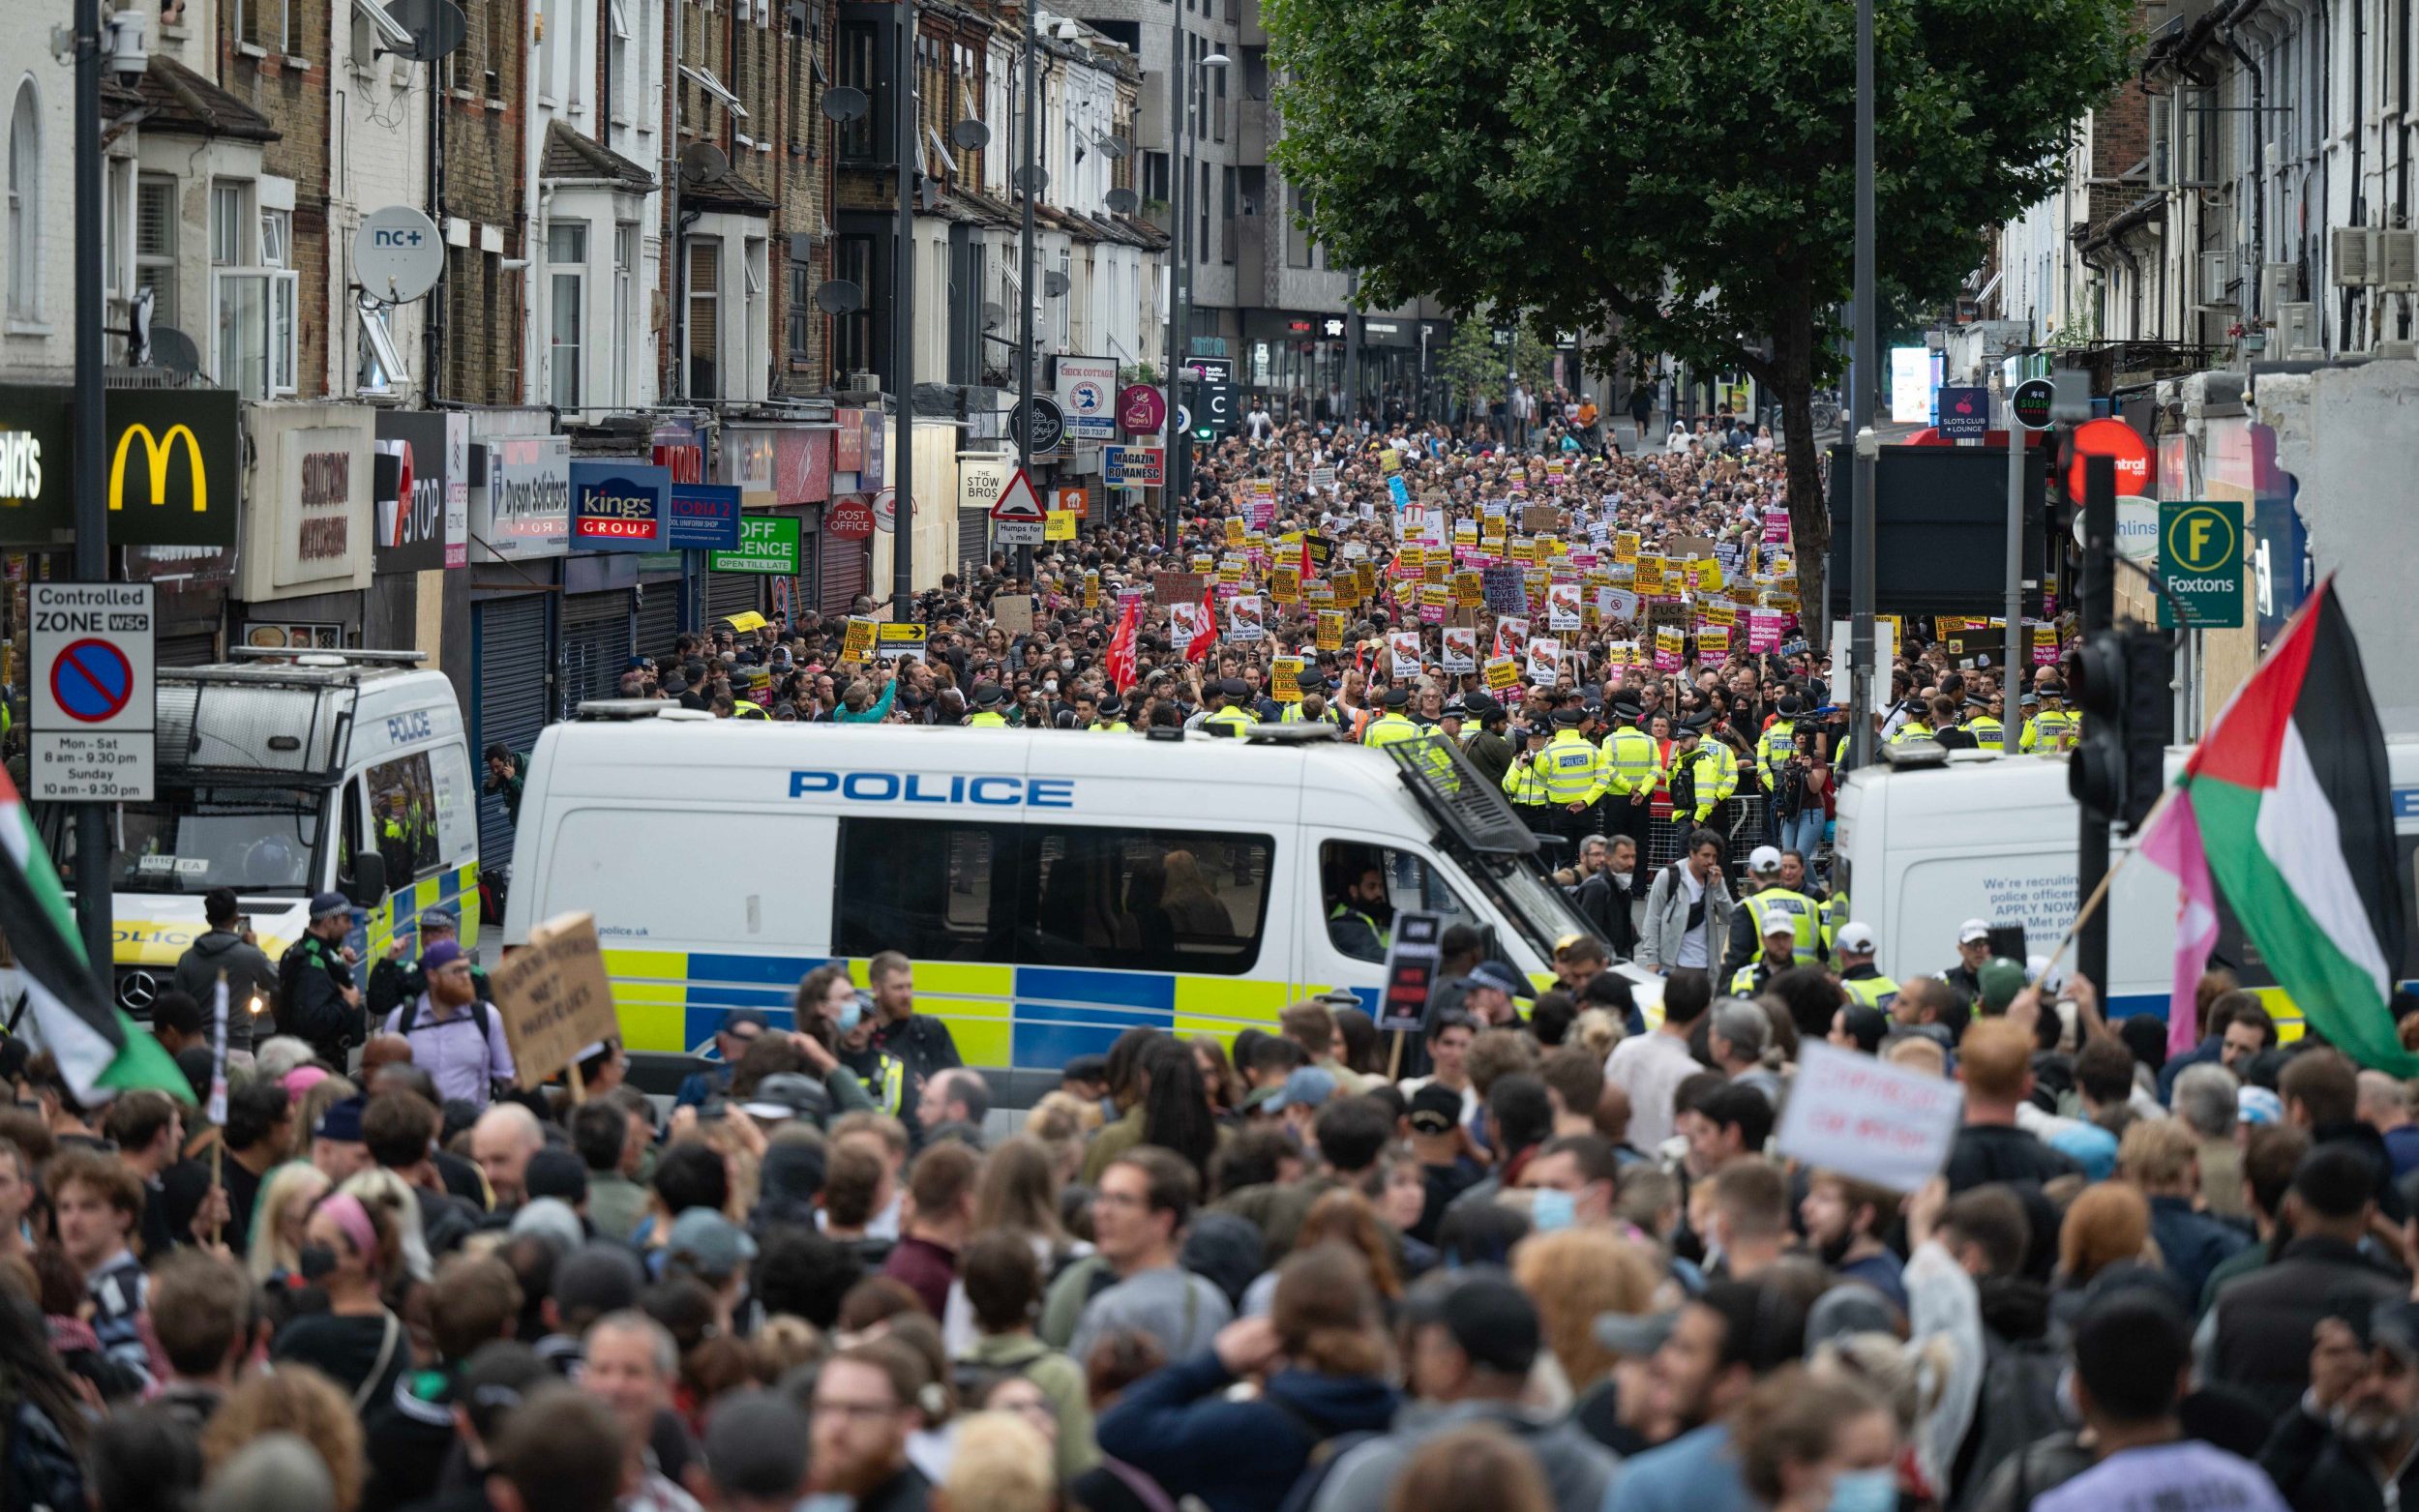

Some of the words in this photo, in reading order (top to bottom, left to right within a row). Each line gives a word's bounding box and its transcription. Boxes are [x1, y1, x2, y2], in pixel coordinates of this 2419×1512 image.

[375, 230, 422, 246] nc+
[1084, 370, 1115, 378] COTTAGE
[1128, 416, 1150, 425] Pepe's
[1113, 454, 1155, 464] MAGAZIN
[1108, 467, 1159, 479] ROMANESC
[967, 477, 1000, 488] STOW
[506, 479, 531, 524] Dyson
[532, 471, 567, 512] Solicitors
[968, 488, 998, 499] BROS
[584, 489, 652, 519] kings
[722, 503, 731, 517] 2
[837, 511, 866, 520] POST
[583, 521, 650, 534] GROUP
[703, 519, 719, 528] SHOP
[830, 520, 870, 531] OFFICE
[1000, 524, 1027, 533] Humps
[1030, 524, 1041, 533] for
[740, 522, 777, 539] OFF
[2190, 519, 2214, 561] F
[719, 560, 745, 569] OPEN
[746, 560, 764, 569] TILL
[766, 561, 790, 570] LATE
[1637, 557, 1657, 566] SMASH
[2166, 576, 2234, 592] Foxtons
[39, 588, 144, 606] Controlled
[1490, 604, 1523, 613] HERE
[1652, 605, 1684, 615] FUCK
[1709, 608, 1735, 617] Refugees
[36, 612, 104, 632] ZONE
[110, 614, 148, 631] WSC
[850, 621, 869, 631] SMASH
[1943, 619, 1965, 628] RACISM
[1750, 625, 1780, 635] Refugees
[849, 632, 872, 642] FASCISM
[1657, 650, 1670, 659] Stop
[1487, 665, 1509, 674] Oppose
[1490, 672, 1510, 681] Tommy
[1492, 678, 1518, 689] Robinson
[387, 711, 432, 745] POLICE
[59, 738, 86, 750] Mon
[97, 738, 118, 750] Sat
[45, 752, 53, 763] 8
[56, 754, 75, 763] am
[86, 752, 115, 763] 9.30
[118, 754, 137, 767] pm
[1560, 755, 1588, 767] POLICE
[68, 768, 114, 786] Sunday
[44, 784, 57, 795] 10
[60, 786, 78, 795] am
[90, 784, 123, 795] 9.30
[126, 786, 140, 797] pm
[789, 770, 1074, 808] POLICE
[1984, 877, 2021, 889] We're
[1990, 892, 2028, 904] police
[1995, 904, 2039, 916] APPLY
[2043, 902, 2079, 913] NOW
[2027, 917, 2053, 928] Met
[598, 927, 649, 937] police.uk
